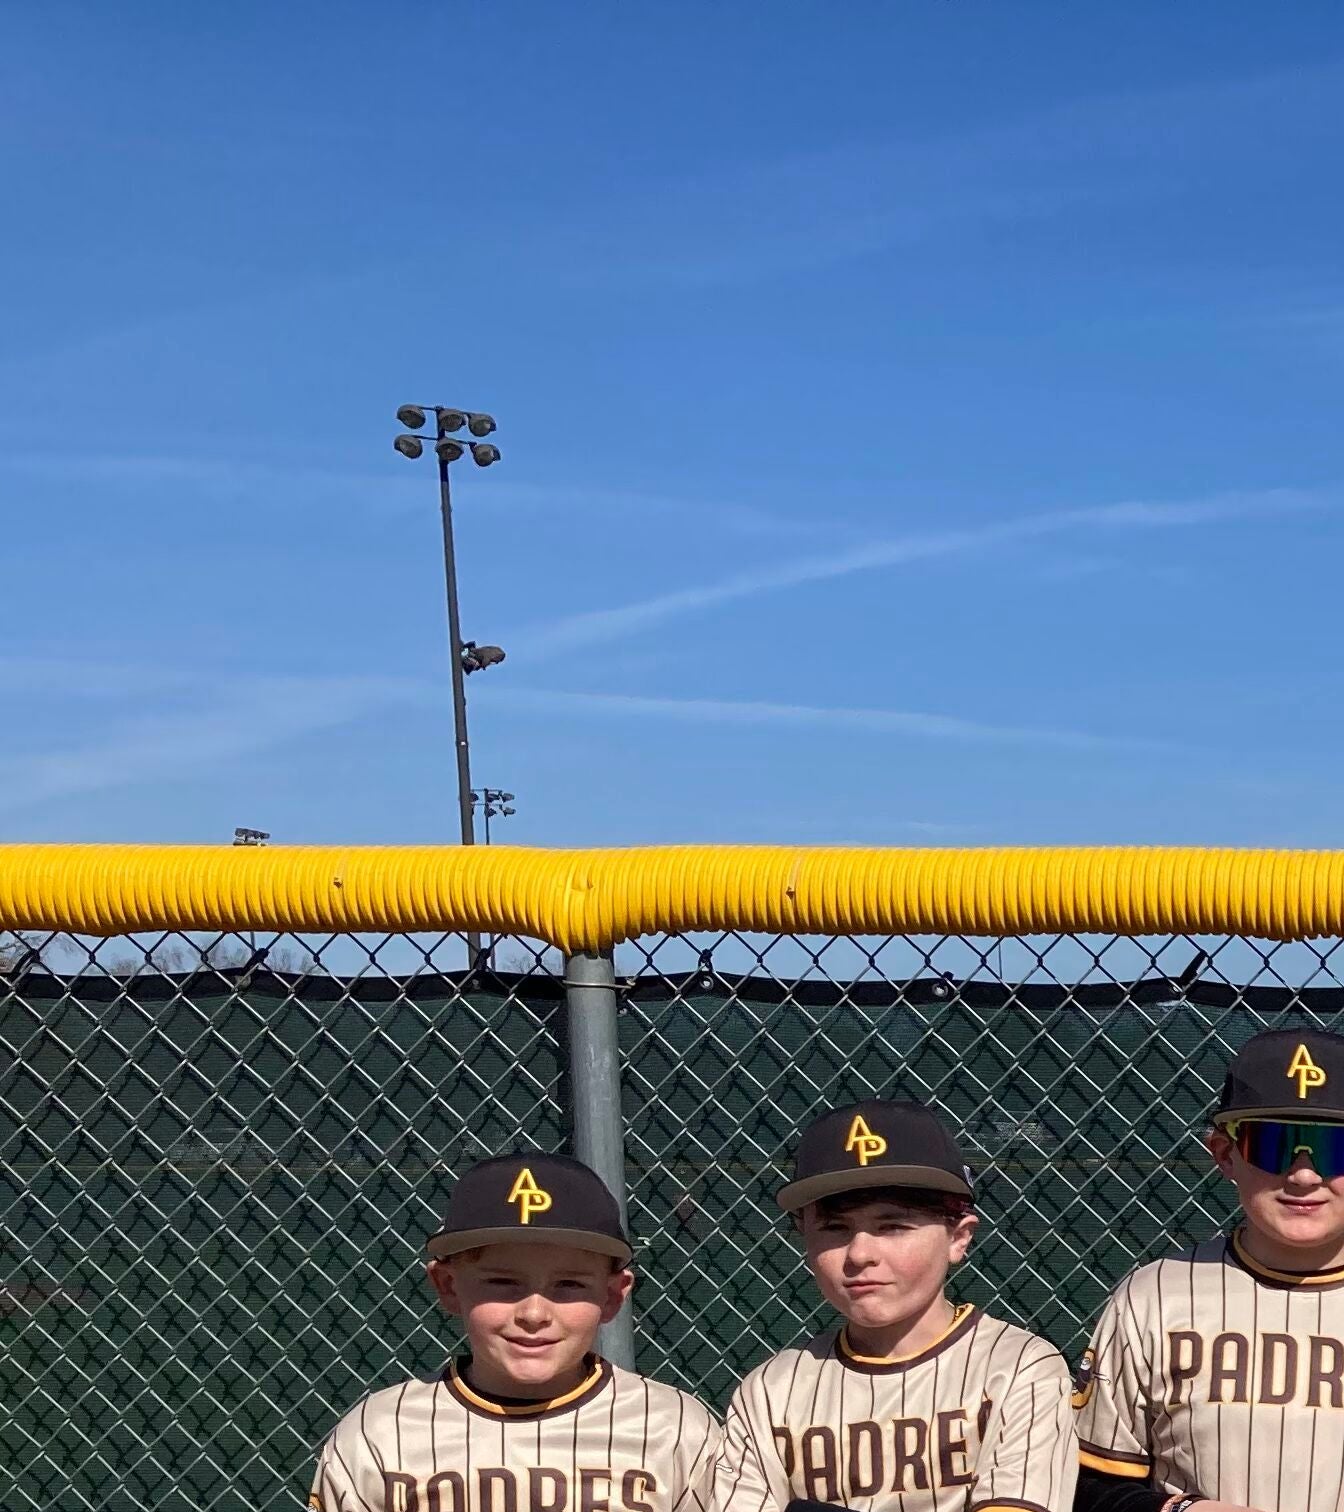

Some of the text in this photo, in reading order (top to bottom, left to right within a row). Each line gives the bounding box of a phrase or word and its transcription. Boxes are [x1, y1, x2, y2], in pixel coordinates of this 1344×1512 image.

[1286, 1044, 1327, 1099] AP
[844, 1114, 888, 1167] AP
[506, 1167, 553, 1225] AP
